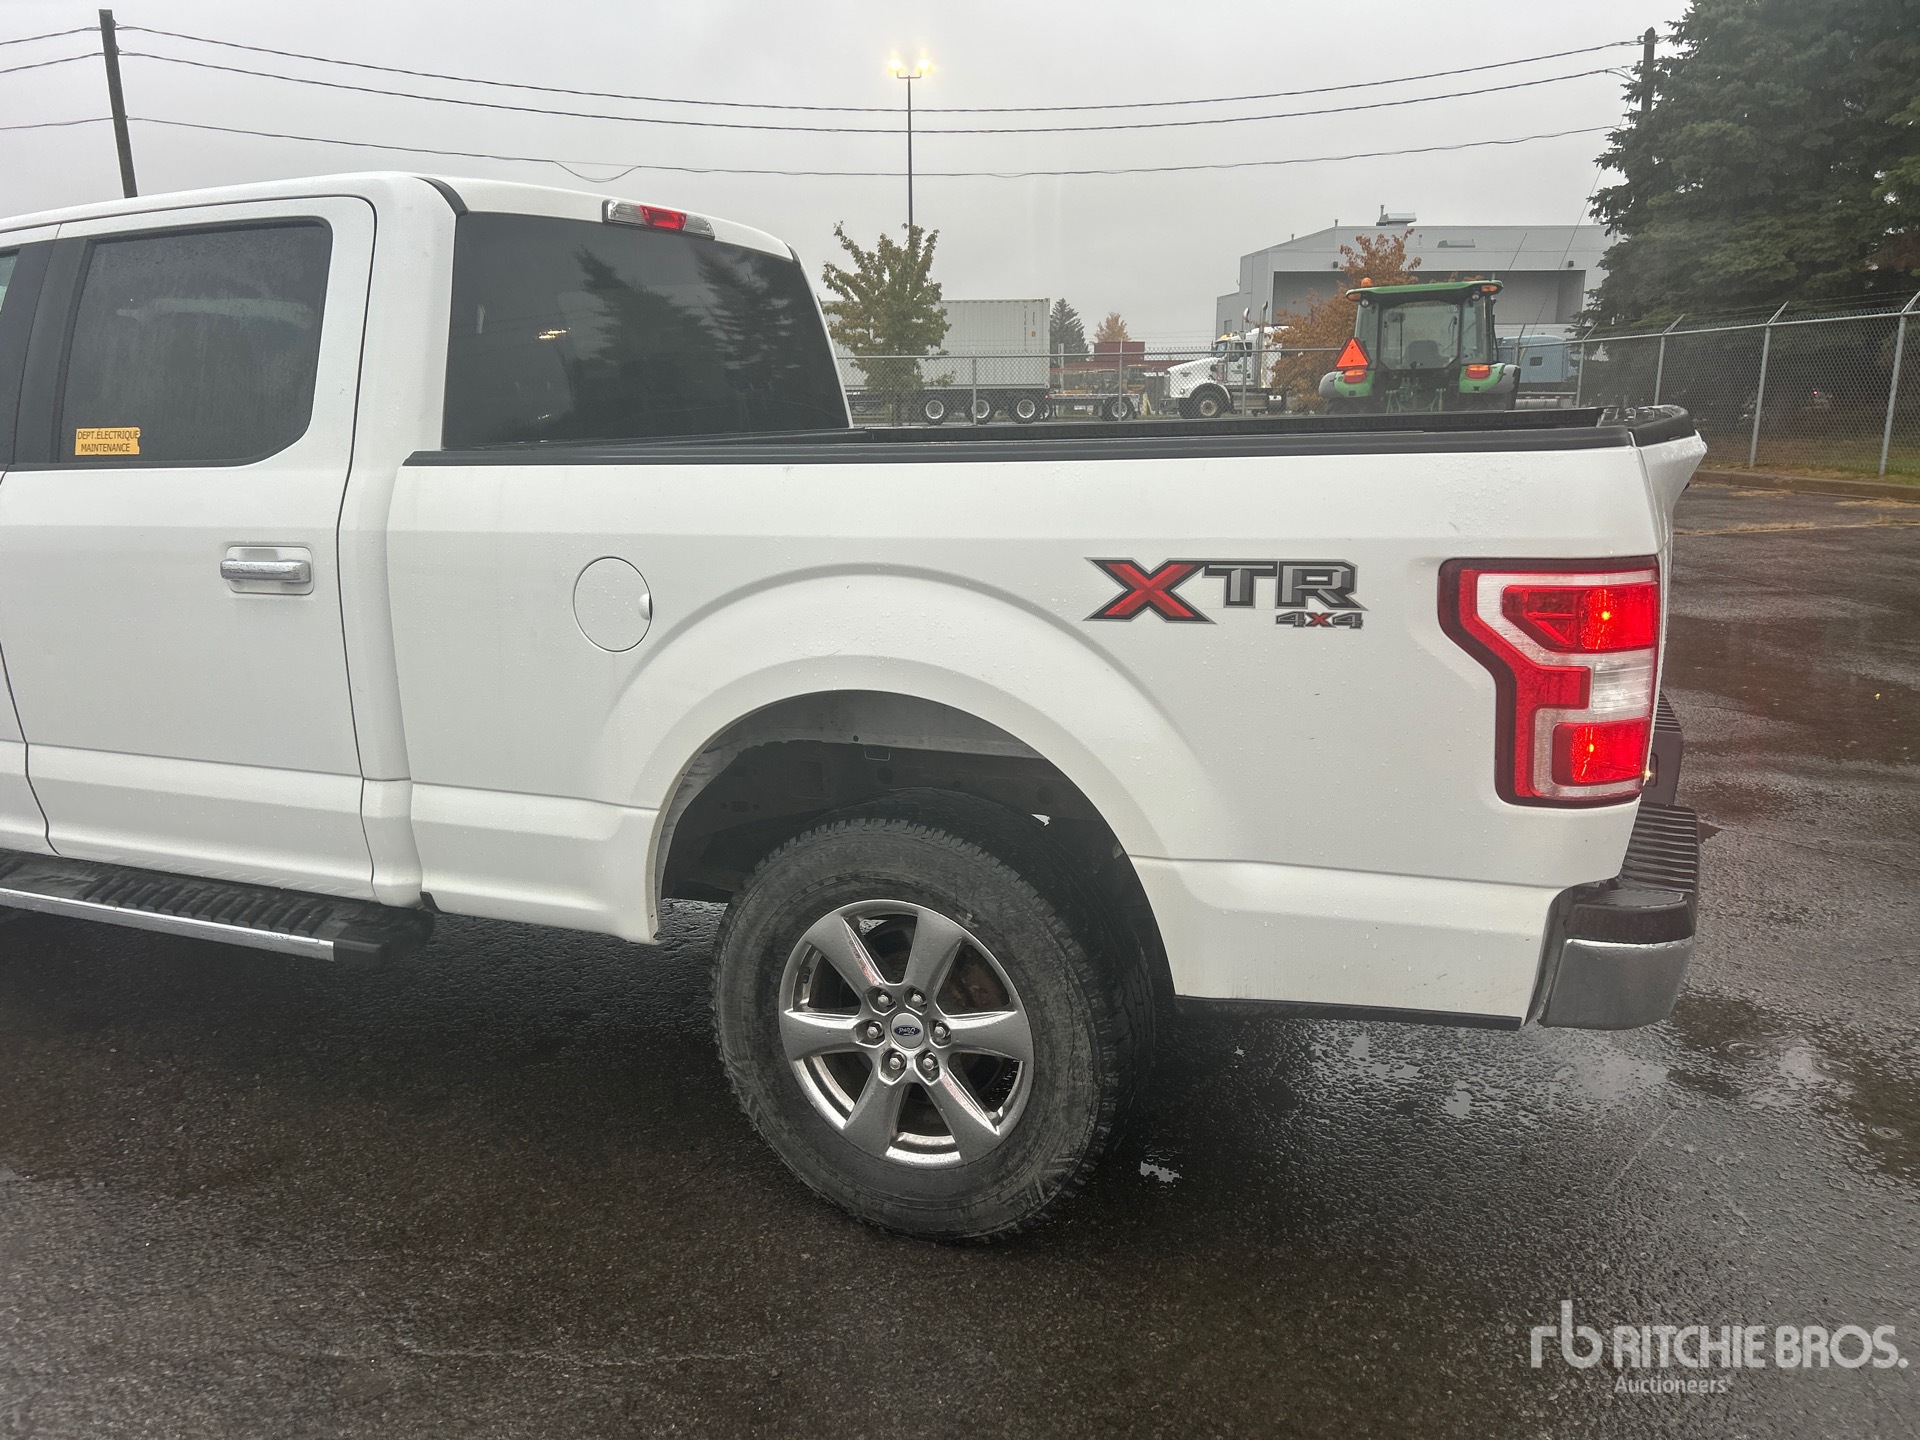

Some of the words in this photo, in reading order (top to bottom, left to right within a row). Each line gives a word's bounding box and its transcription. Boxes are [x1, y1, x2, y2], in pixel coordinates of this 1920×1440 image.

[81, 443, 130, 452] MAINTENANCE
[1083, 557, 1368, 625] XTR
[896, 1026, 917, 1036] Ford
